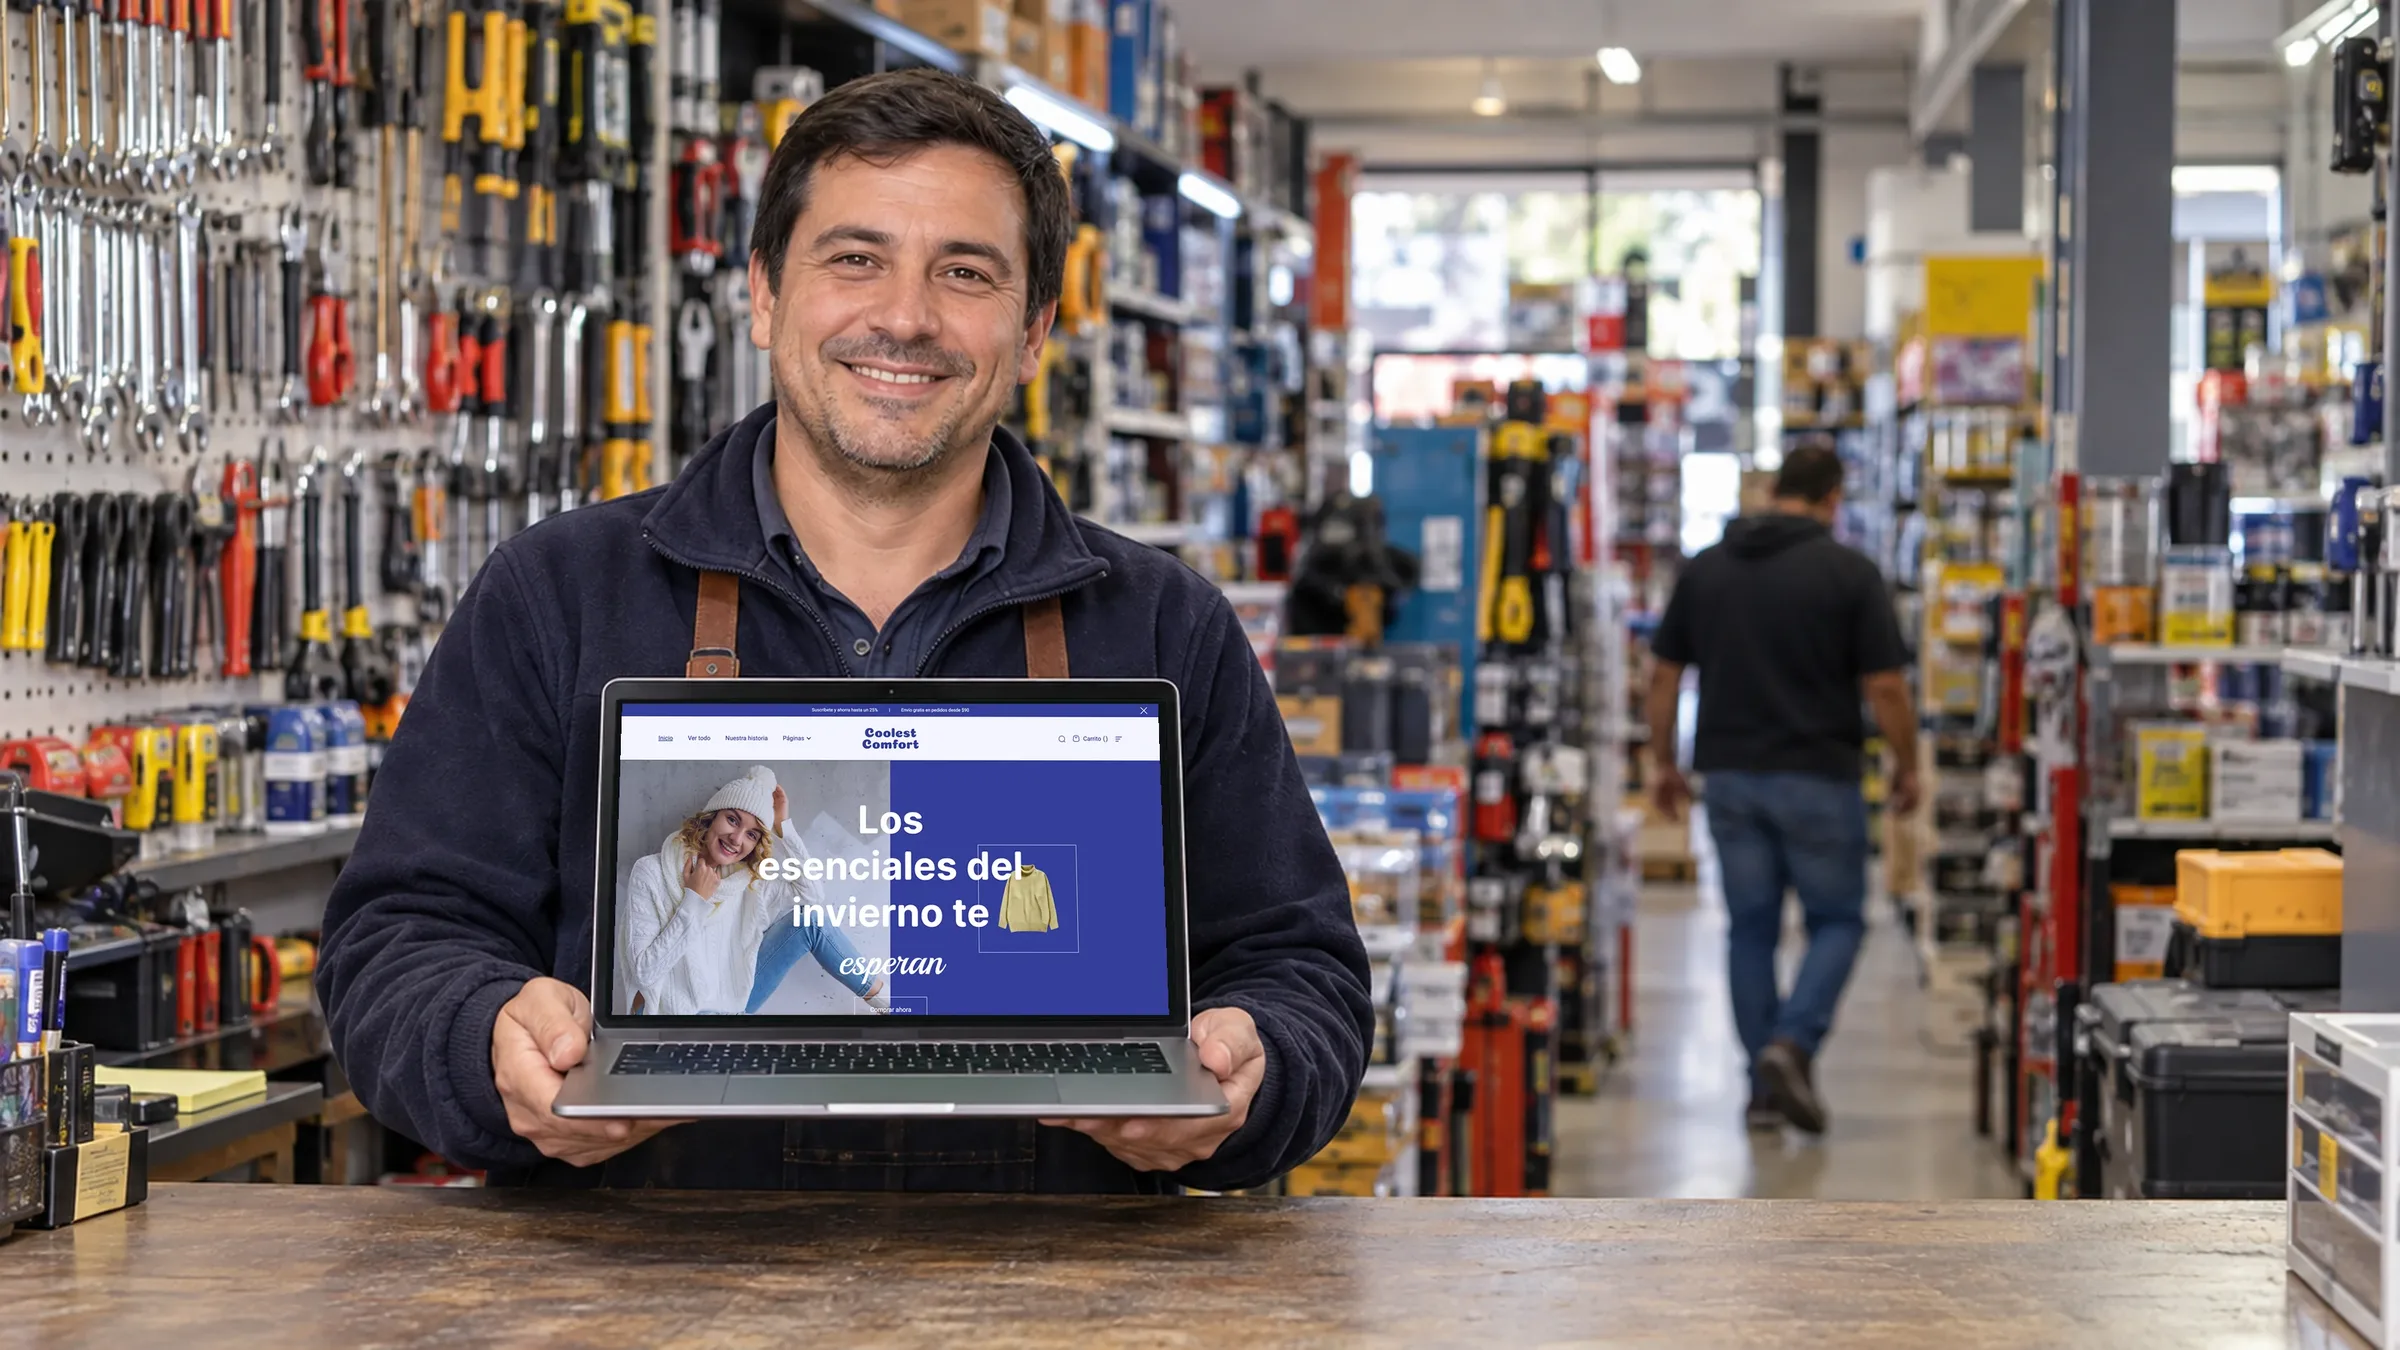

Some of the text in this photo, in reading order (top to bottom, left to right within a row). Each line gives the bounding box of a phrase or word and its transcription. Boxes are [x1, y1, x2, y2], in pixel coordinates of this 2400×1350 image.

[782, 735, 805, 743] Páginas
[864, 727, 917, 738] Coolest
[862, 738, 919, 750] Comfort
[859, 804, 924, 835] Los
[758, 850, 1022, 881] esenciales del
[793, 896, 989, 928] invierno te
[839, 955, 947, 985] esperan
[869, 1006, 895, 1014] Comprar
